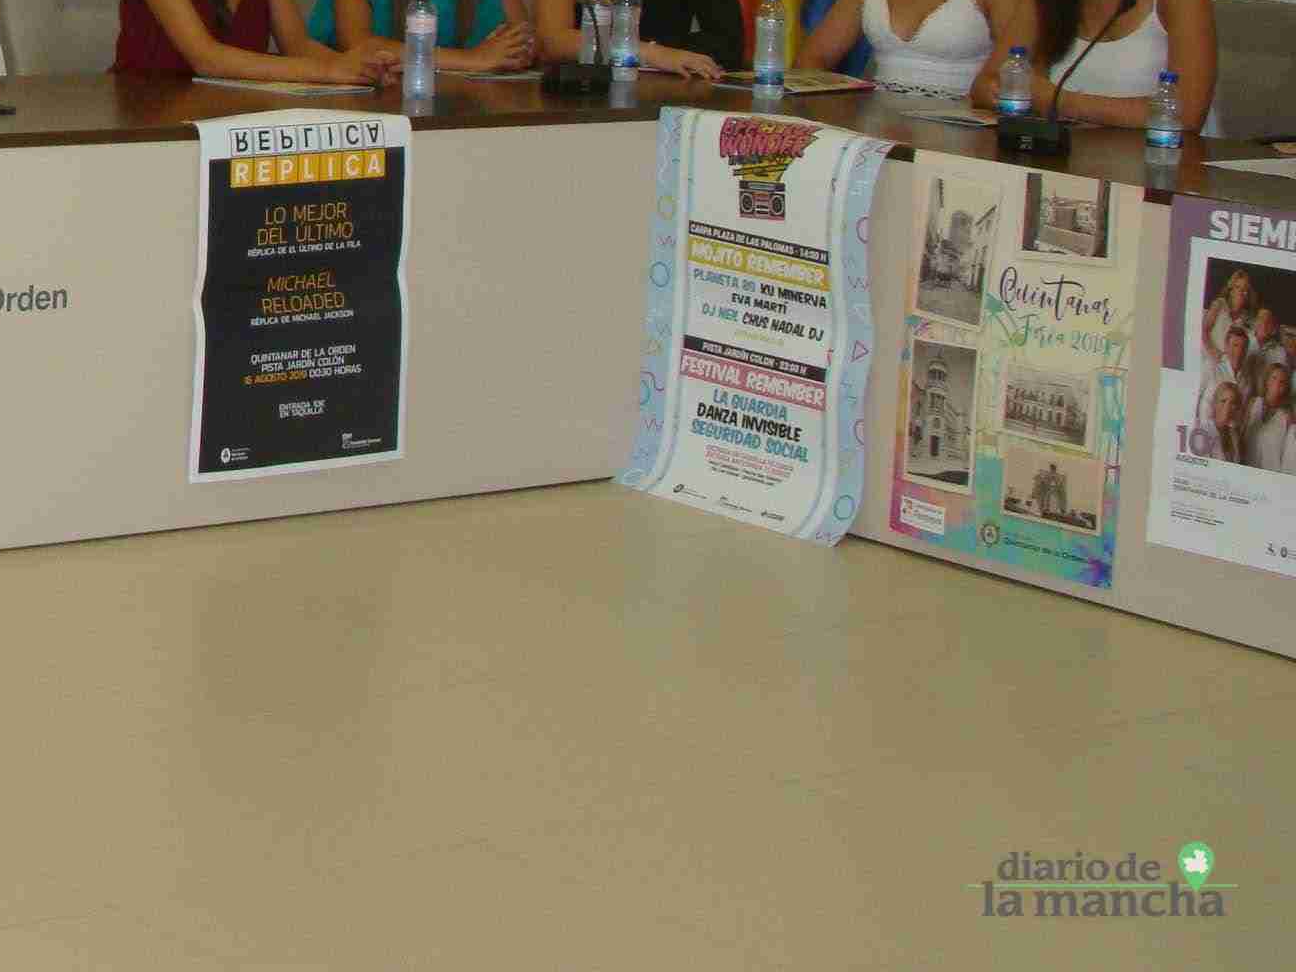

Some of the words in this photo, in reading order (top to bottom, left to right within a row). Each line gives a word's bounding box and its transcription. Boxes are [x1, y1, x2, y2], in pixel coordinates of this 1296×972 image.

[235, 153, 381, 184] REPLICA
[264, 206, 286, 225] LO
[293, 201, 347, 221] MEJOR
[257, 228, 288, 246] DEL
[691, 239, 743, 268] MOJITO
[267, 270, 337, 293] MICHAEL
[693, 267, 740, 288] PLANETA
[777, 286, 827, 309] MINERVA
[261, 292, 345, 314] RELOADED
[731, 292, 751, 306] EVA
[999, 266, 1114, 325] Quintanar
[702, 302, 715, 316] DJ
[742, 311, 769, 328] CHUS
[770, 318, 806, 338] NADAL
[808, 327, 825, 342] DJ
[250, 349, 298, 365] QUINTANAR
[301, 348, 312, 359] DE
[314, 347, 326, 358] LA
[327, 344, 356, 356] ORDEN
[261, 362, 284, 373] PISTA
[334, 364, 362, 375] HORAS
[681, 354, 741, 385] FESTIVAL
[746, 371, 824, 406] REMEMBER
[713, 388, 729, 404] LA
[696, 402, 738, 427] DANZA
[741, 416, 803, 442] INVISIBLE
[691, 418, 762, 449] SEGURIDAD
[765, 435, 809, 463] SOCIAL
